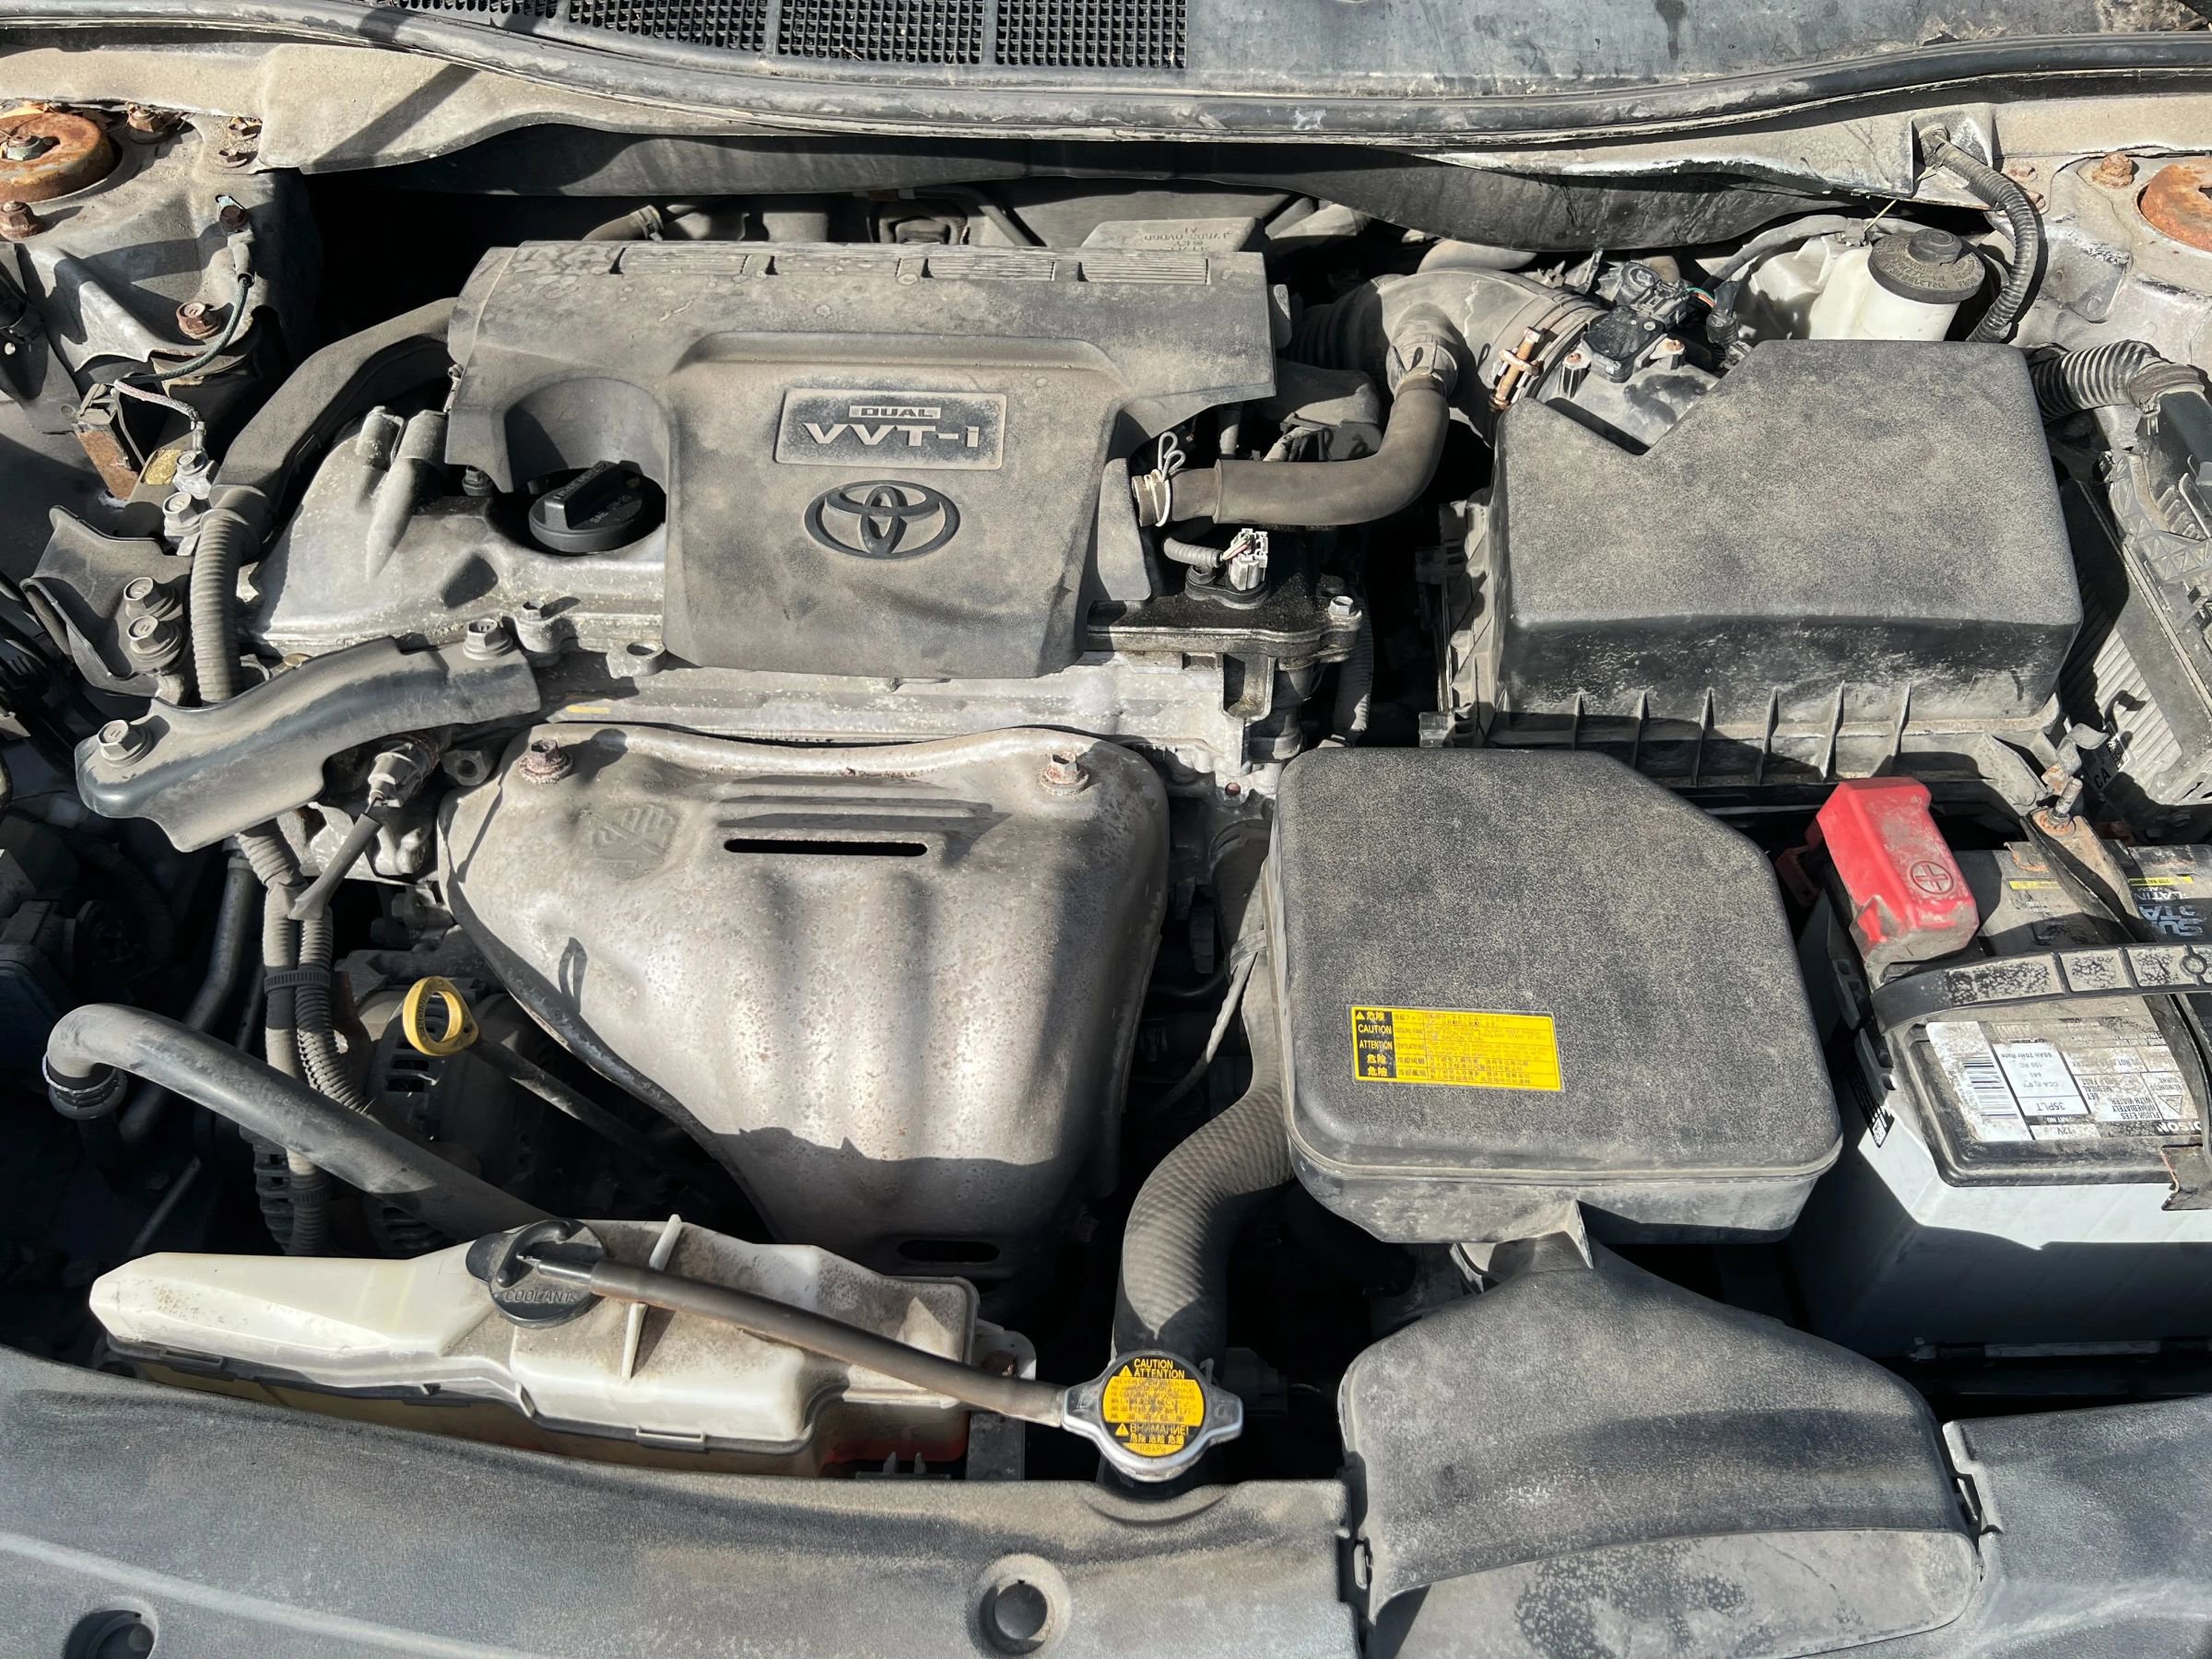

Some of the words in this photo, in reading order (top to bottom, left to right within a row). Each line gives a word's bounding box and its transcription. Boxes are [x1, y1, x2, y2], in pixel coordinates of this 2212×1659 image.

[860, 407, 934, 418] DUAL
[803, 422, 980, 448] VVT-i
[1358, 1023, 1393, 1034] CAUTION
[1359, 1039, 1393, 1050] ATTENTION
[2035, 1101, 2065, 1112] 35PLT
[504, 1289, 573, 1302] COOLANT
[1134, 1358, 1173, 1370] CAUTION
[1134, 1369, 1185, 1380] ATTENTION
[1113, 1378, 1138, 1386] NEVER
[1129, 1423, 1190, 1436] ВНИМАНИЕ!
